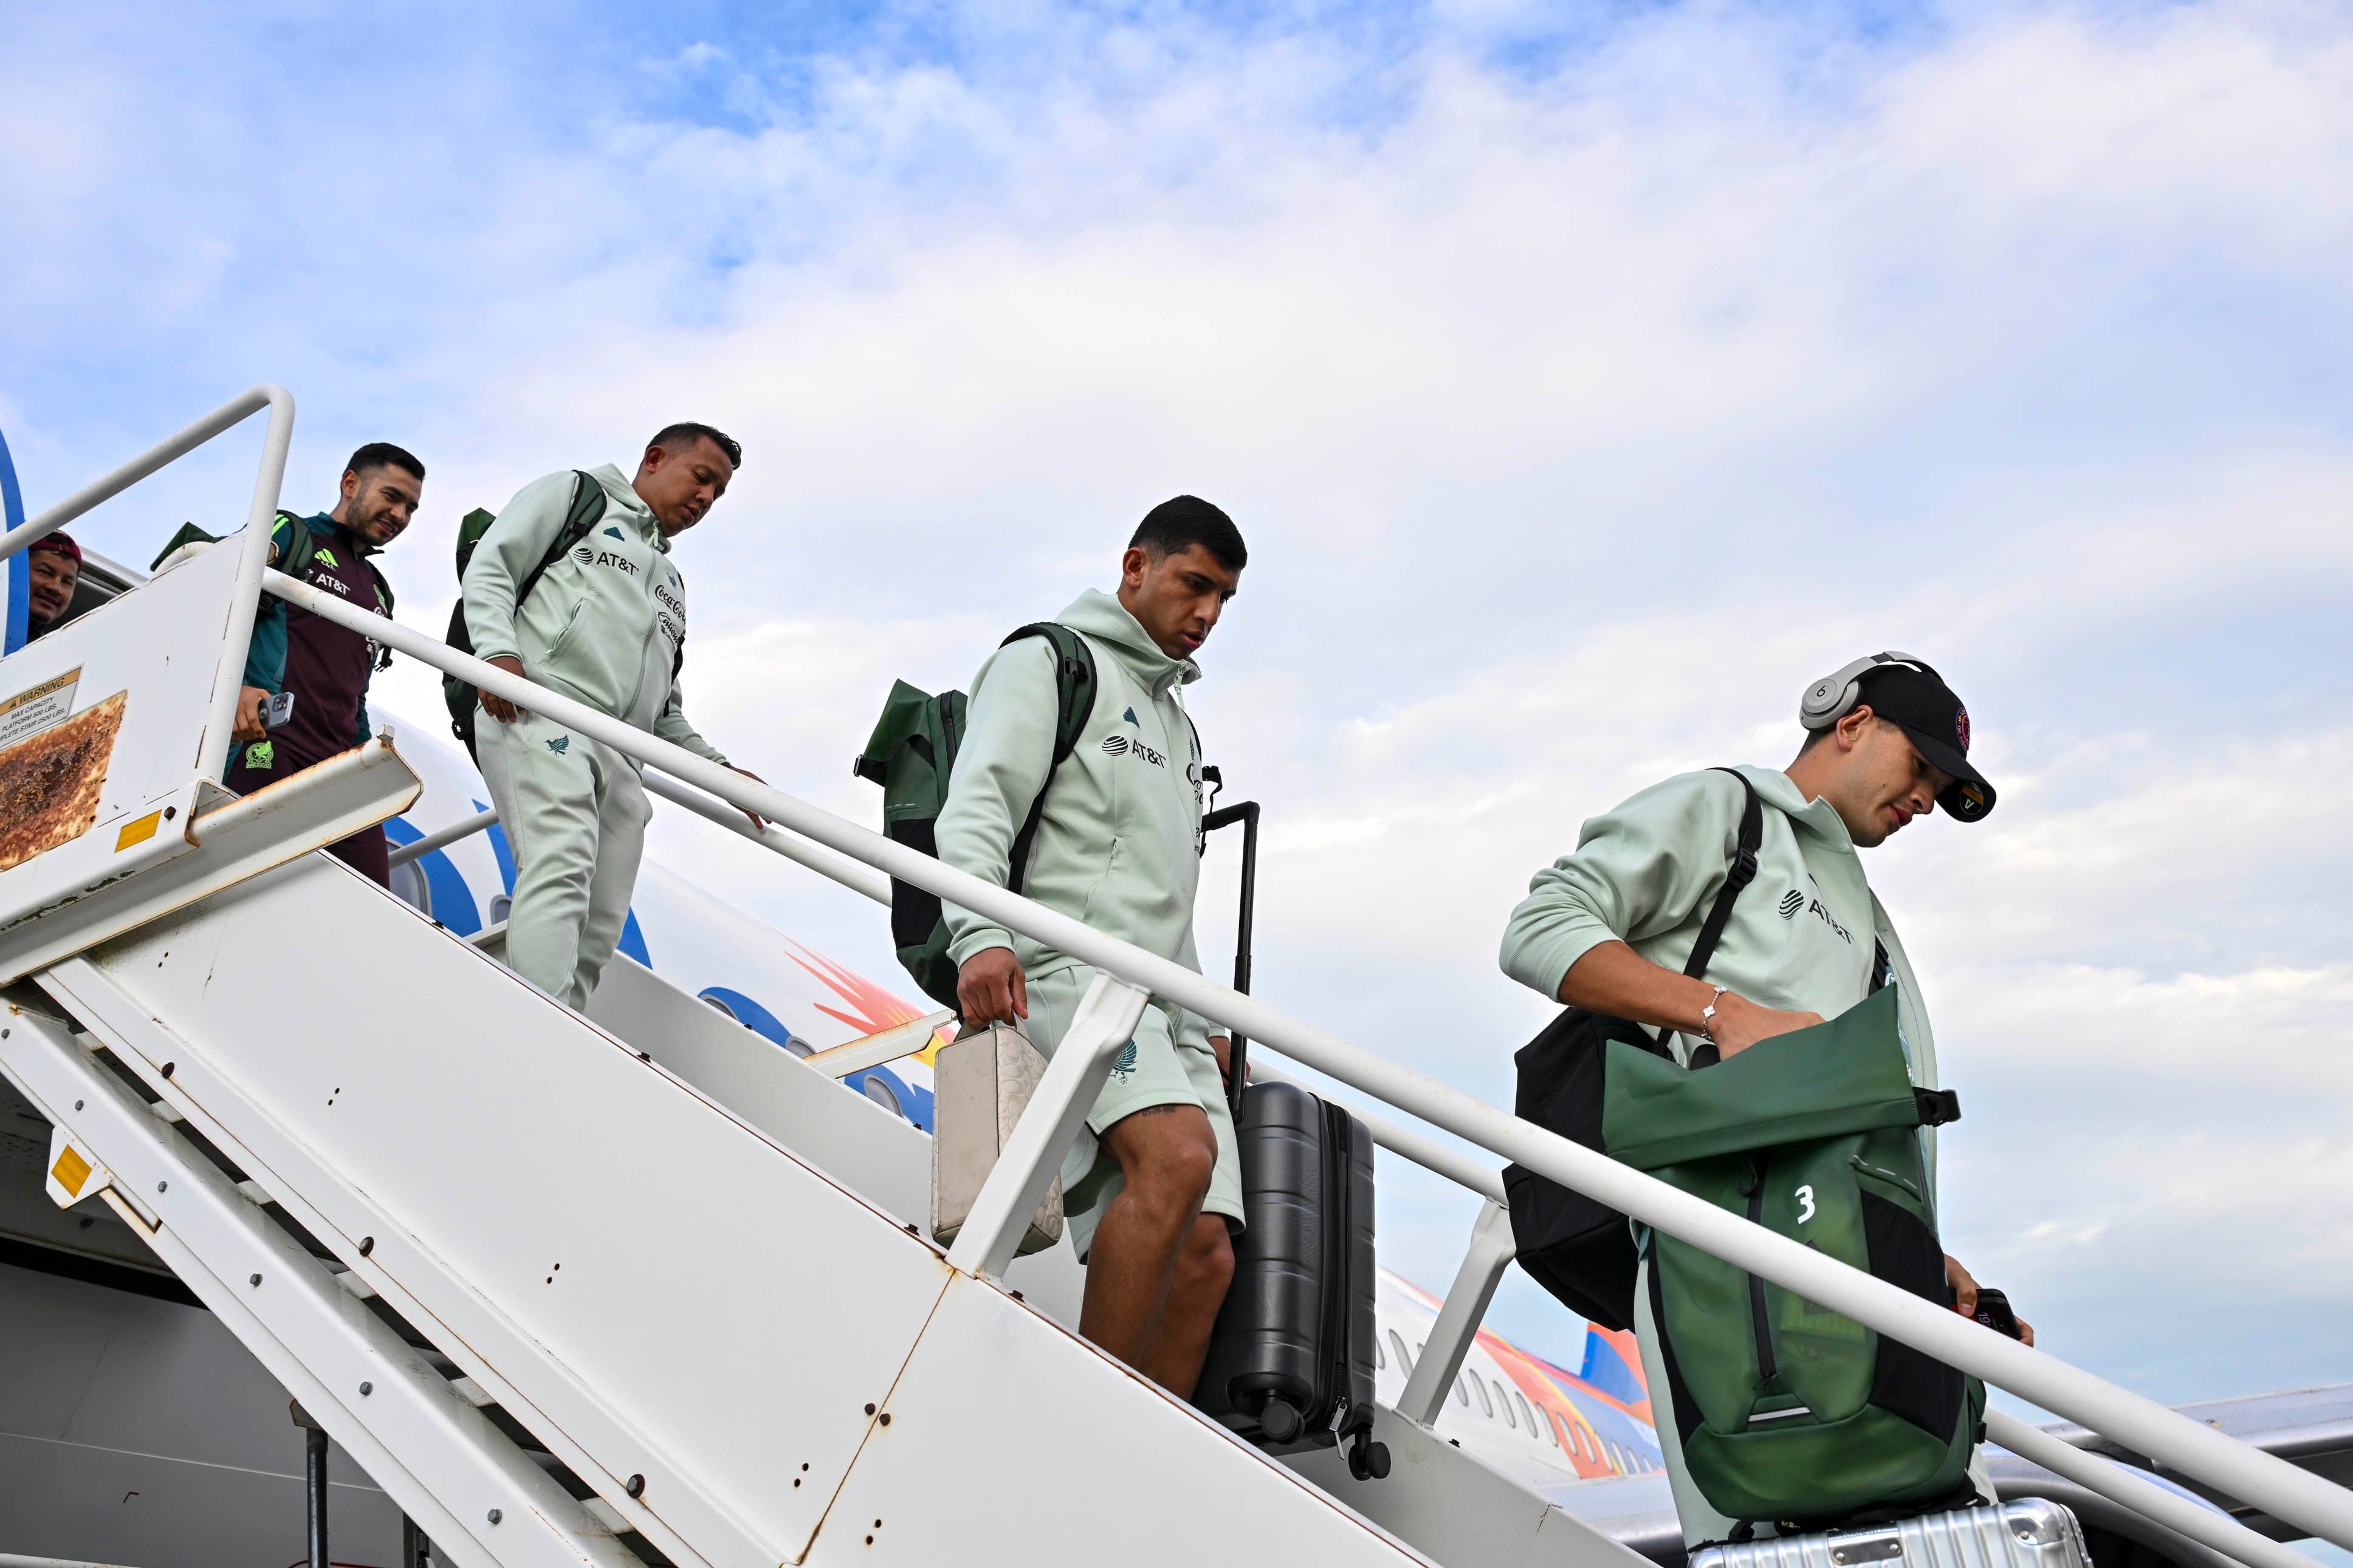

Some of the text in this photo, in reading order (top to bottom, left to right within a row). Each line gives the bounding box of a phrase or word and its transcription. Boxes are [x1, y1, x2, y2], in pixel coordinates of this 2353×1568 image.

[597, 552, 634, 576] AT&T
[315, 573, 351, 595] AT&T
[654, 584, 686, 626] Coca-Col
[20, 677, 64, 704] WARNING
[11, 696, 54, 719] MAX CAPACITY
[2, 714, 32, 733] PLATFORM
[32, 709, 44, 718] 500
[19, 721, 37, 732] STAIR
[37, 714, 52, 724] 2500
[1132, 739, 1164, 769] AT&T
[1808, 899, 1854, 945] AT&T
[1795, 1184, 1815, 1225] 3
